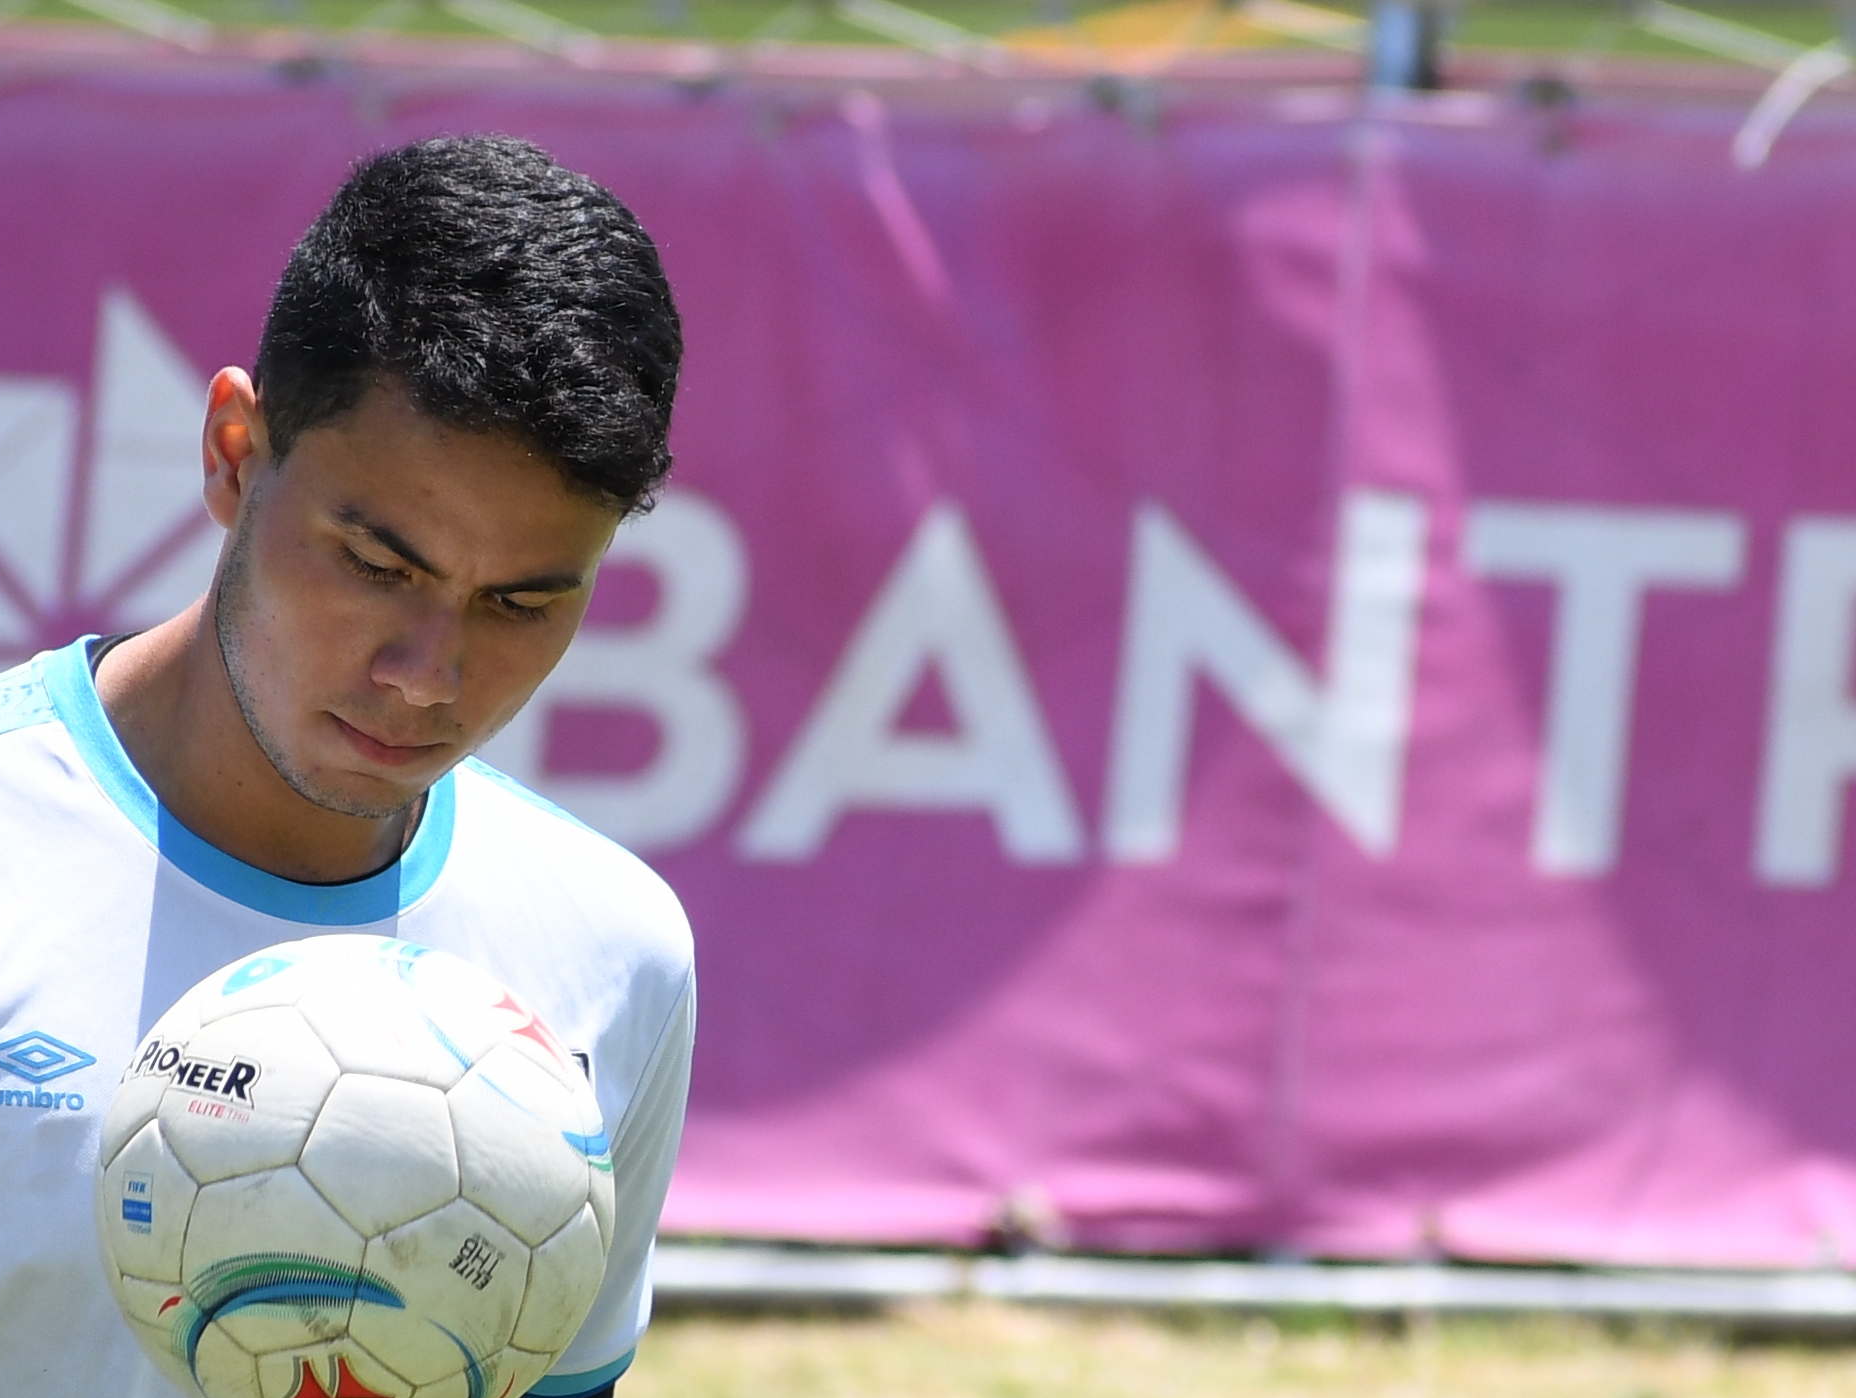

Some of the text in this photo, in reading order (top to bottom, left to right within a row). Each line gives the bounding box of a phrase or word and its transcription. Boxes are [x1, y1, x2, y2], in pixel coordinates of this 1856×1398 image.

[135, 1039, 256, 1101] PIONEER
[188, 1100, 227, 1119] ELITE
[448, 1255, 493, 1291] ELITE
